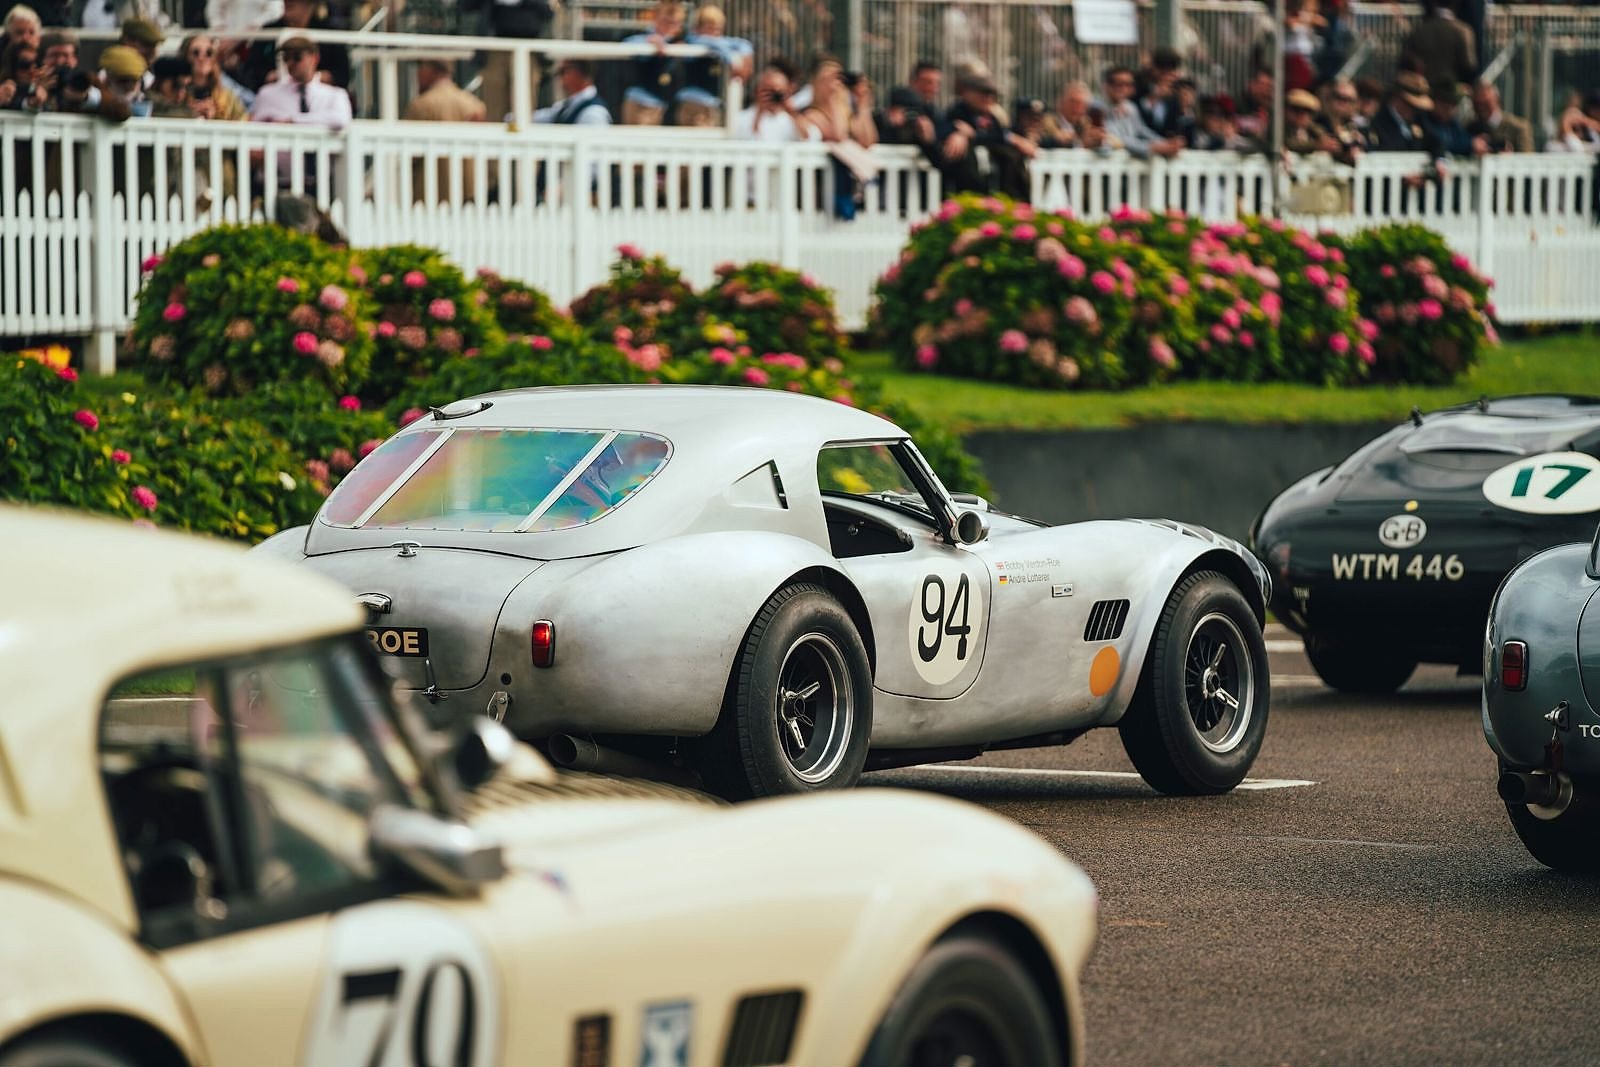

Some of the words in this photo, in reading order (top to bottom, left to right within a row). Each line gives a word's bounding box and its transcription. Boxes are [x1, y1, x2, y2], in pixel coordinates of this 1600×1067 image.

[1510, 464, 1592, 500] 17
[1332, 553, 1400, 580] WTM
[1406, 554, 1465, 581] 446
[917, 572, 971, 663] 94
[367, 630, 420, 653] ROE
[339, 958, 477, 1067] 70
